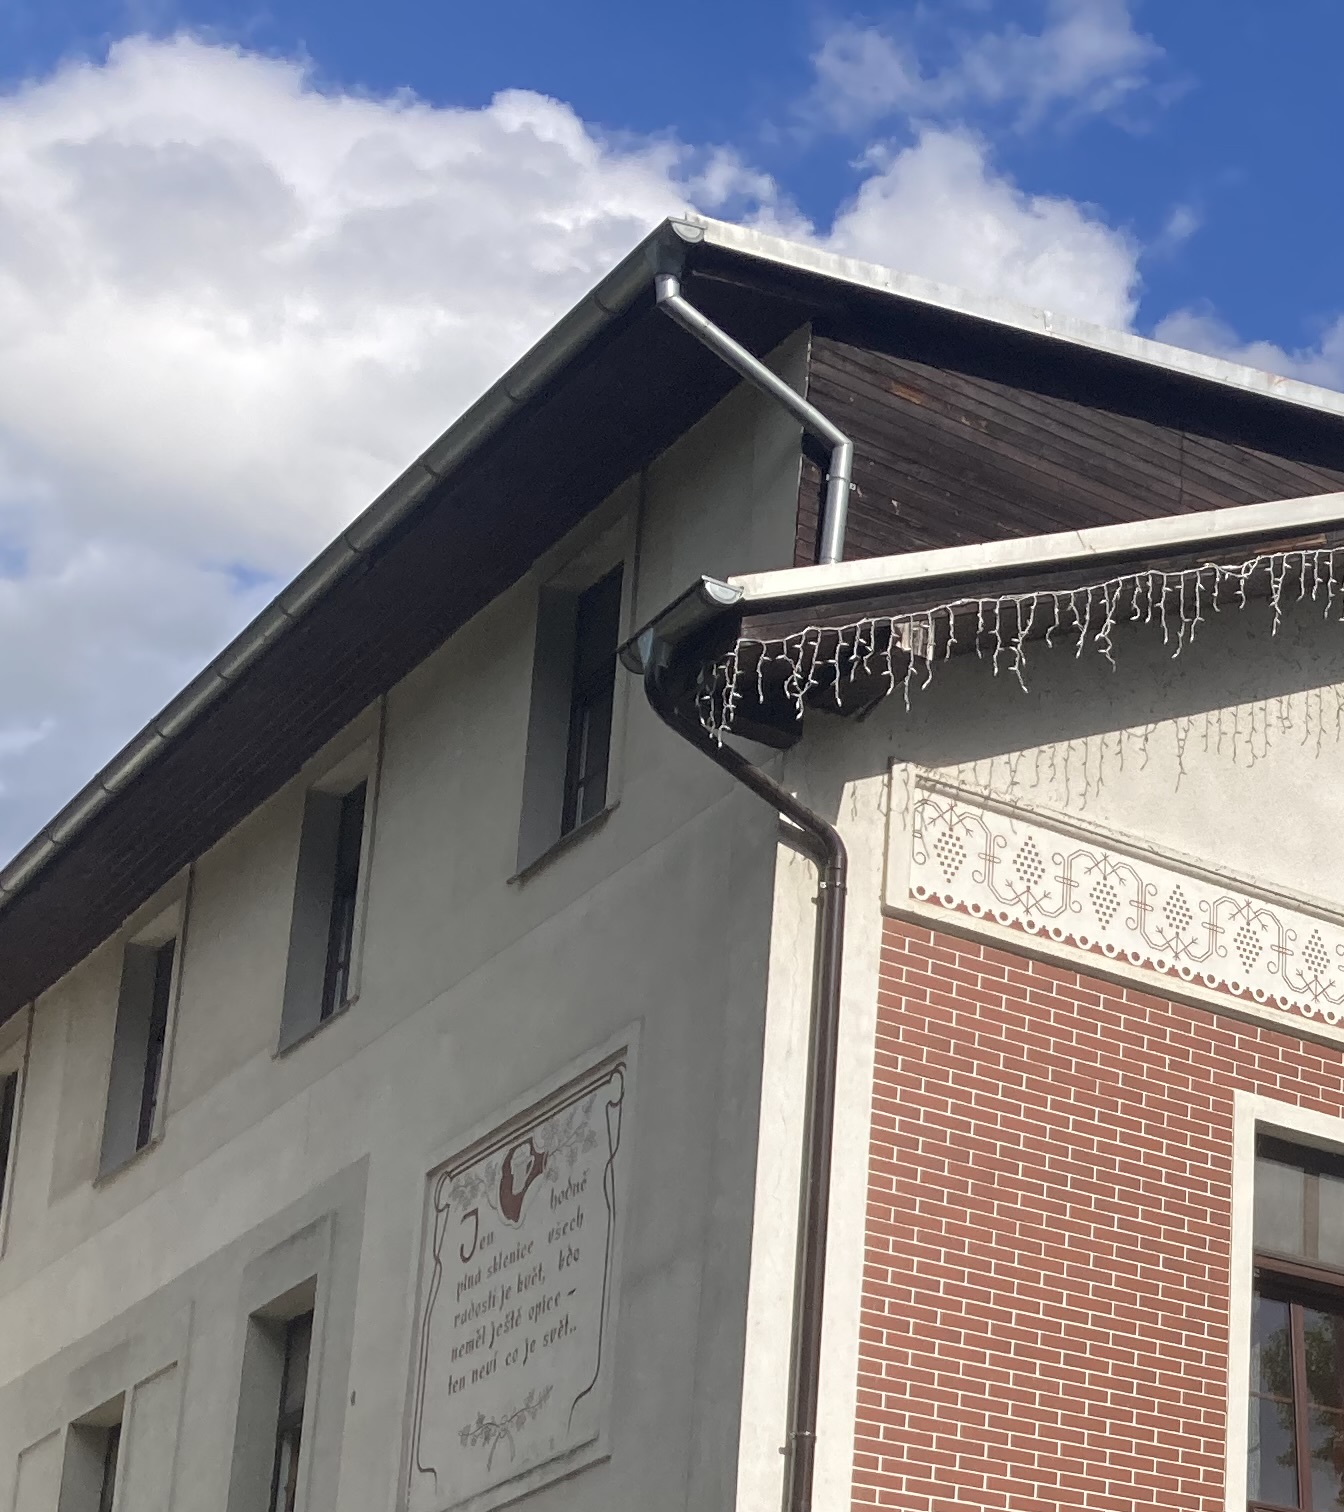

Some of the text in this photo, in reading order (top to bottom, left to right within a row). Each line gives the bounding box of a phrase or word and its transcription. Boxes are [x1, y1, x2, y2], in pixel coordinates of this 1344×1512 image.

[460, 1207, 494, 1264] Jen
[487, 1238, 535, 1279] sklenice
[548, 1205, 584, 1244] všech
[499, 1282, 512, 1310] je
[558, 1246, 581, 1272] kdo
[451, 1322, 487, 1364] neměl
[528, 1290, 562, 1325] opice
[448, 1374, 466, 1397] ten
[471, 1350, 498, 1385] neví
[505, 1348, 519, 1368] co
[523, 1338, 536, 1367] je
